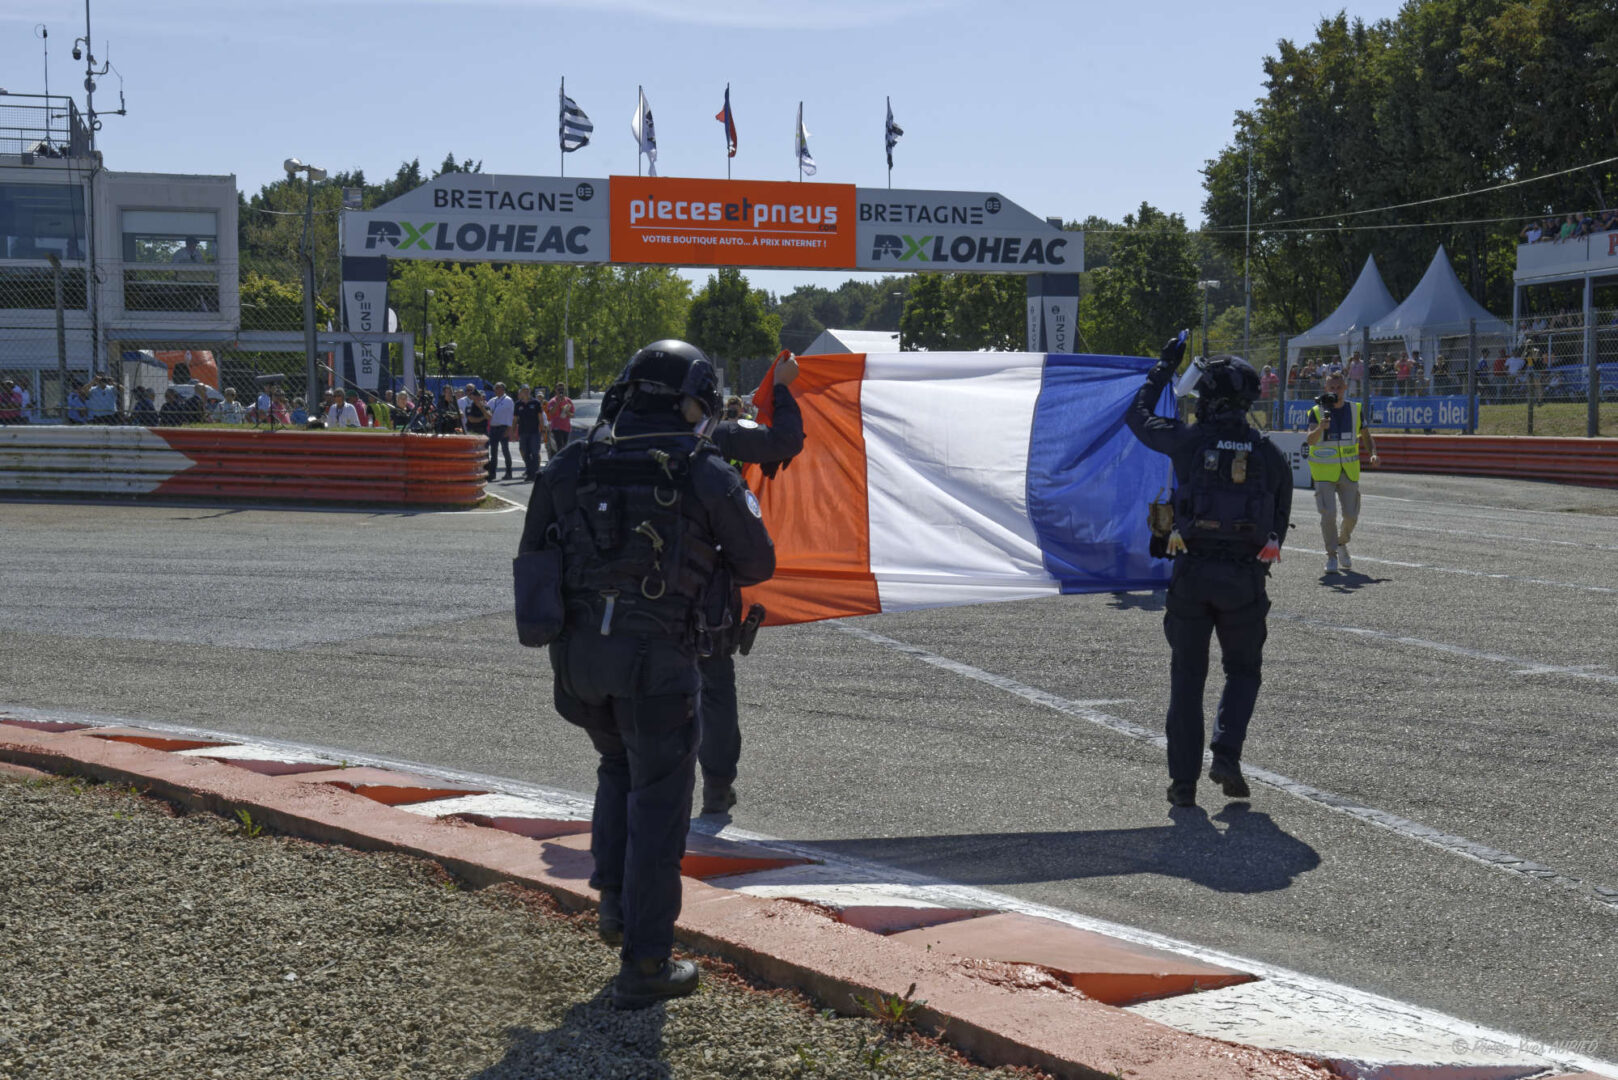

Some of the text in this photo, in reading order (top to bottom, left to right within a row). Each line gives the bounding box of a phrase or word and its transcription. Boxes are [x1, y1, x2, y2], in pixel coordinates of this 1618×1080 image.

[433, 188, 574, 213] BRETAGNE
[630, 195, 838, 228] piecesetpneus
[859, 203, 984, 225] BRETAGNE
[641, 234, 672, 244] VOTRE
[673, 235, 718, 246] BOUTIQUE
[752, 235, 759, 246] À
[760, 238, 780, 247] PRIX
[781, 239, 821, 248] INTERNET
[361, 302, 373, 374] BRETGNE
[1386, 401, 1434, 424] france
